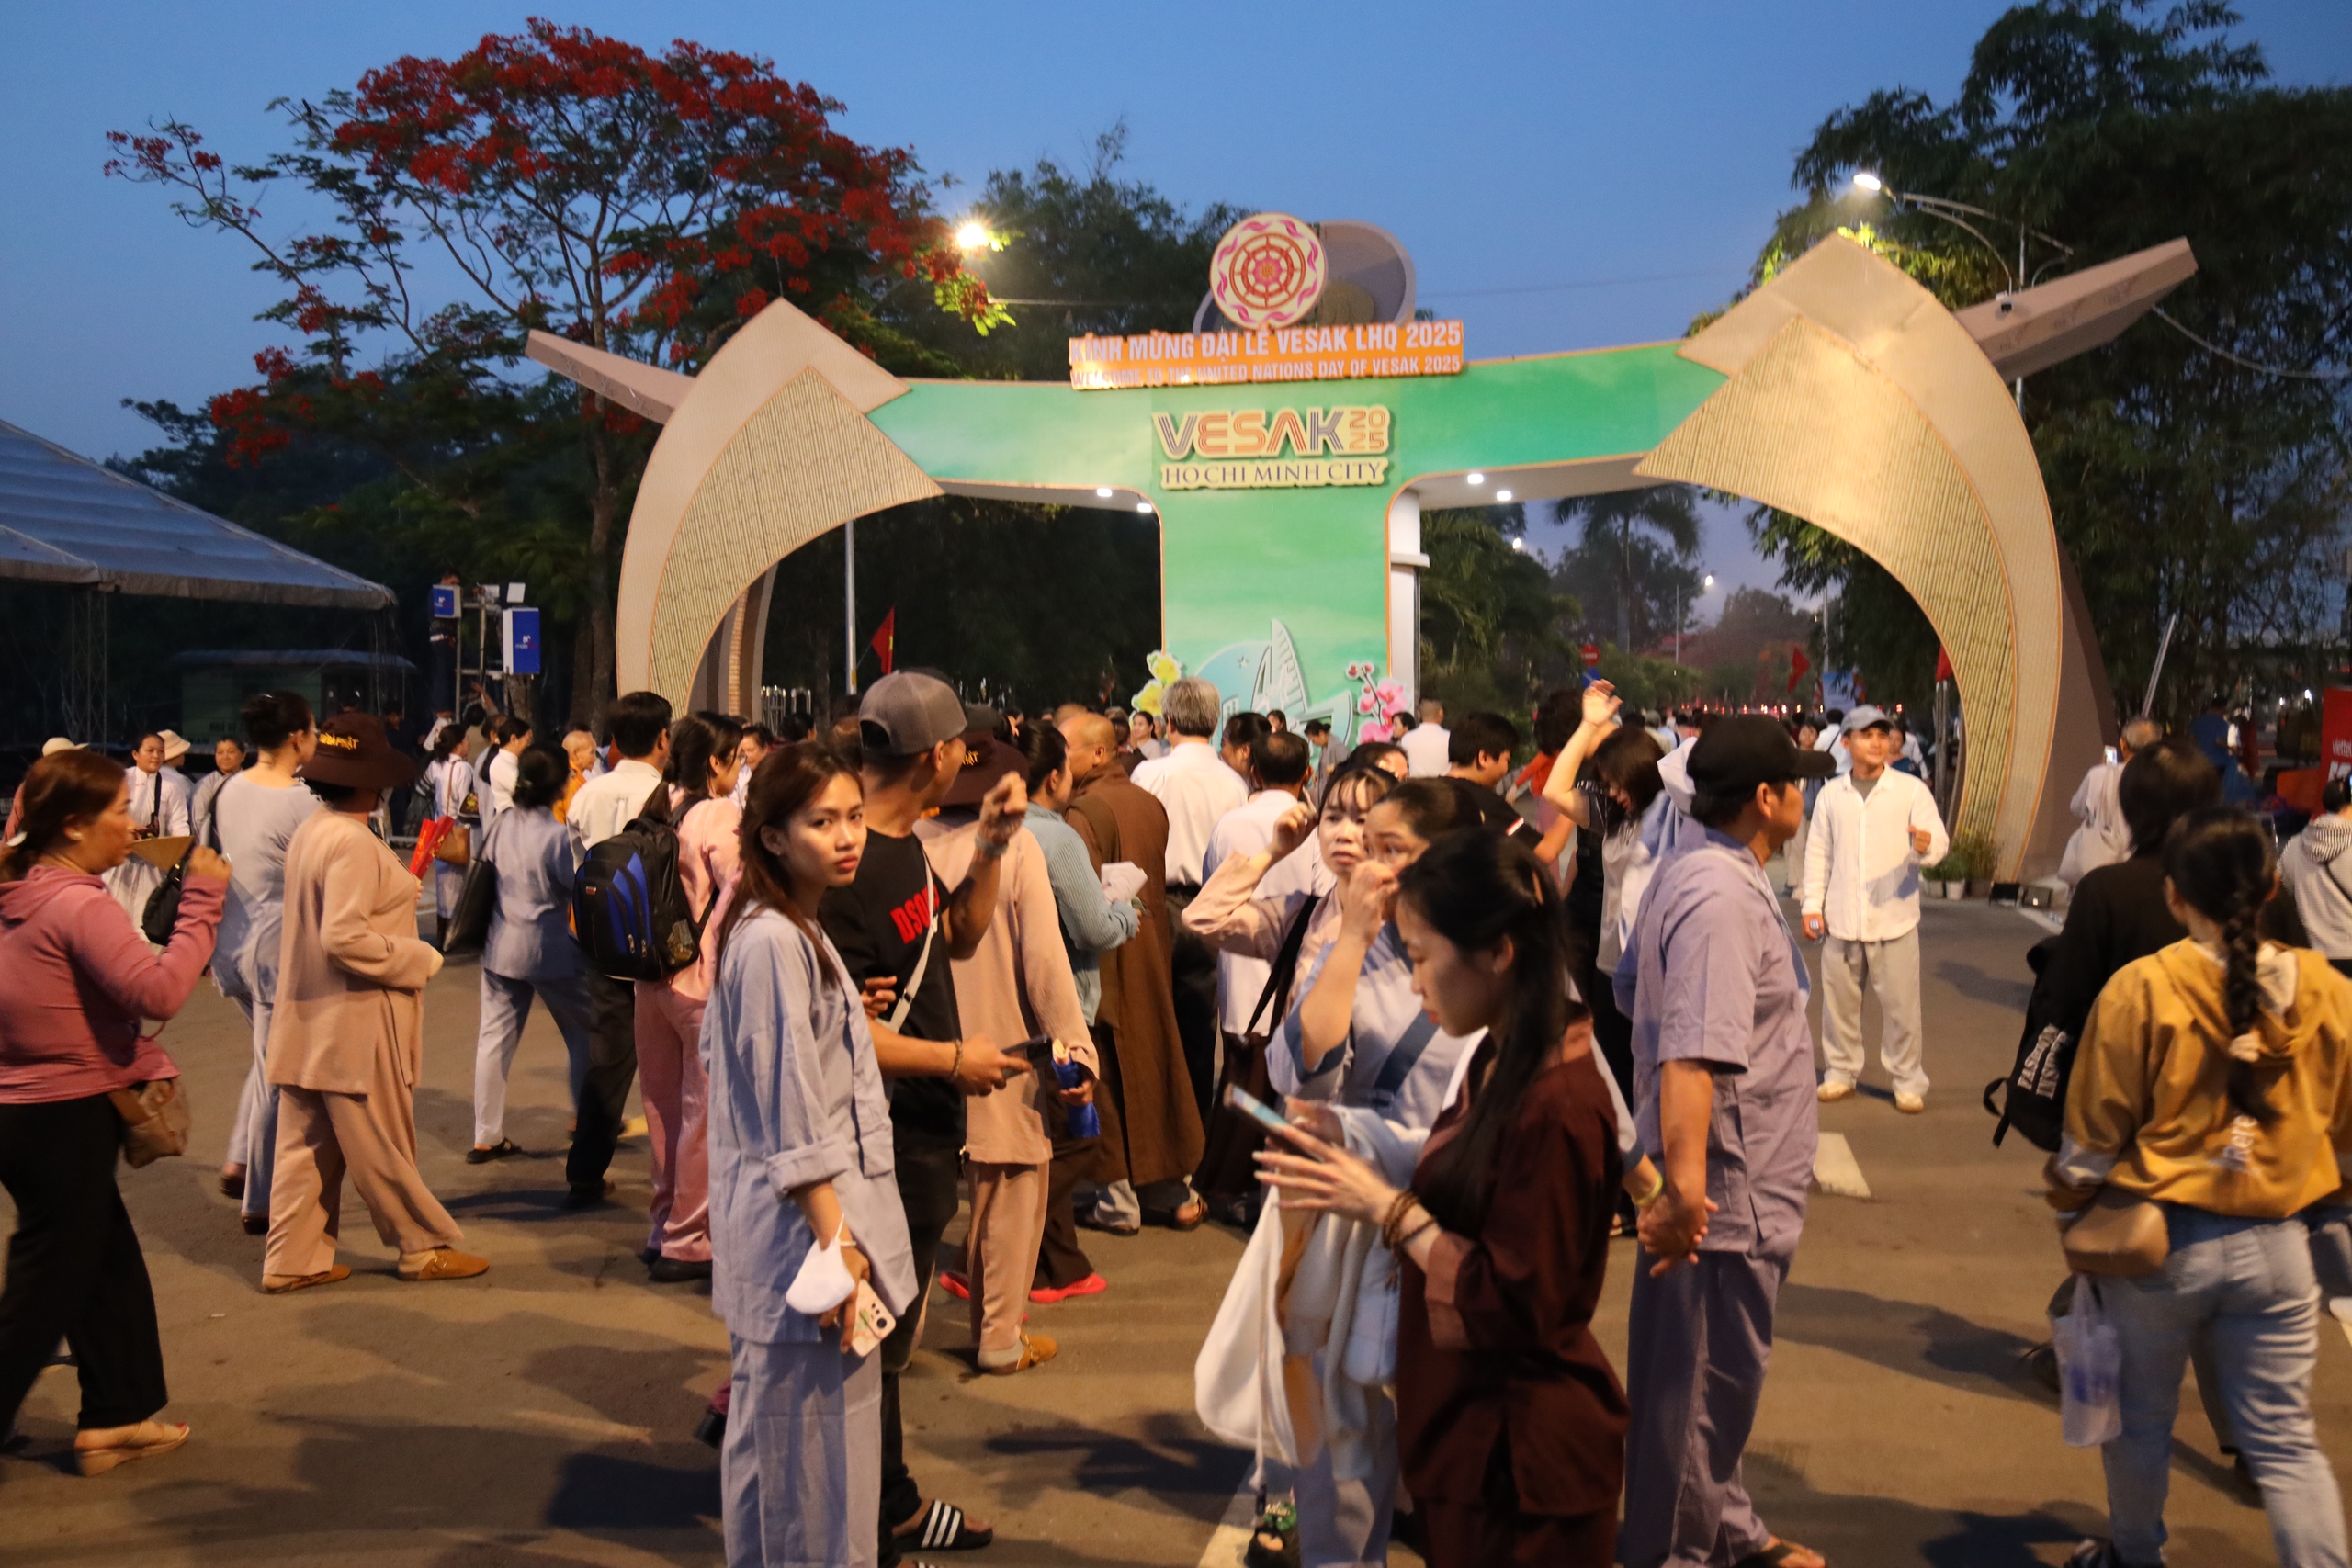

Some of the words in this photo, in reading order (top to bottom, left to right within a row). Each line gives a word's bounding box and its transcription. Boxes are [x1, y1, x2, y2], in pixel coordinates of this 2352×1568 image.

[1129, 330, 1194, 360] MỪNG
[1201, 333, 1238, 362] ĐẠI
[1277, 326, 1348, 355] VESAK
[1355, 323, 1397, 352] LHQ
[1406, 321, 1461, 348] 2025
[1148, 368, 1162, 385] TO
[1197, 364, 1248, 382] UNITED
[1252, 360, 1313, 380] NATIONS
[1318, 359, 1345, 378] DAY
[1350, 358, 1367, 377] OF
[1372, 356, 1419, 375] VESAK
[1424, 355, 1460, 373] 2025
[1157, 410, 1344, 456] VESAK
[1165, 468, 1199, 484] HO
[1204, 466, 1246, 483] CHI
[1254, 464, 1319, 482] MINH
[1328, 462, 1381, 480] CITY
